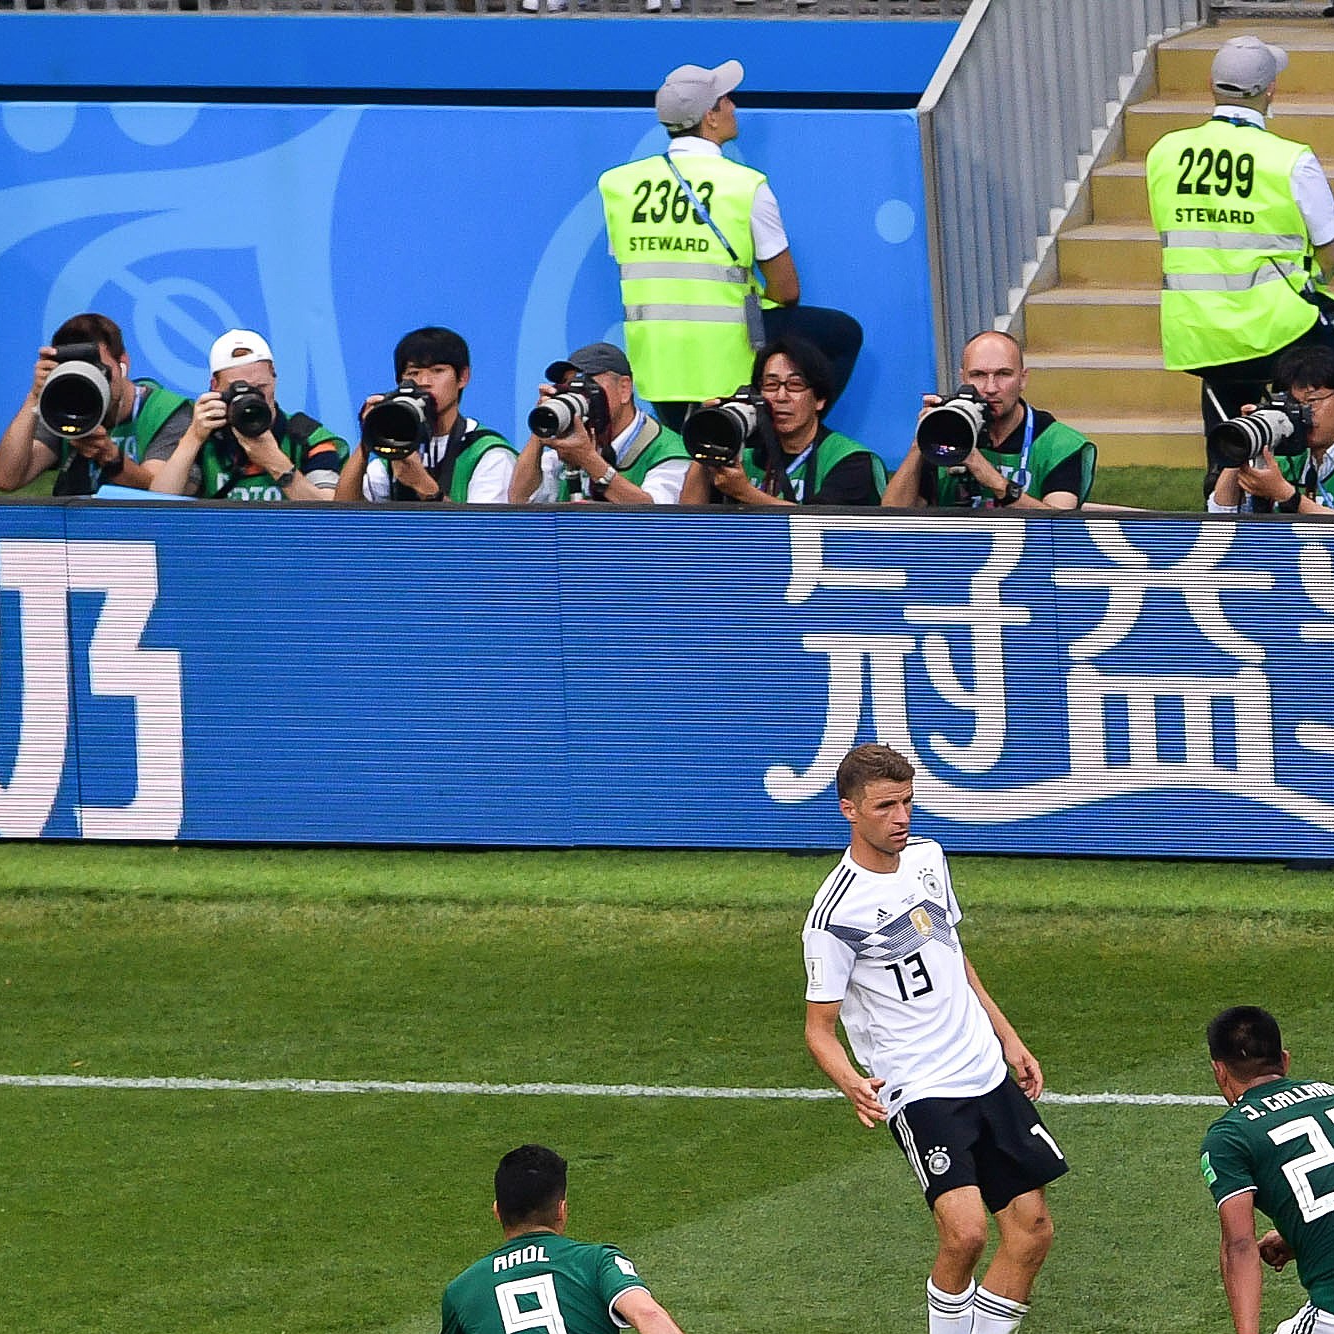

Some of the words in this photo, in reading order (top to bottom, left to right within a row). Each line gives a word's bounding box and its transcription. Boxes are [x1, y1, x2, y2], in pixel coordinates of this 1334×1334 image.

[1176, 147, 1255, 198] 2299
[631, 180, 714, 225] 2363
[1175, 207, 1255, 225] STEWARD
[630, 236, 709, 252] STEWARD
[884, 952, 934, 1002] 13
